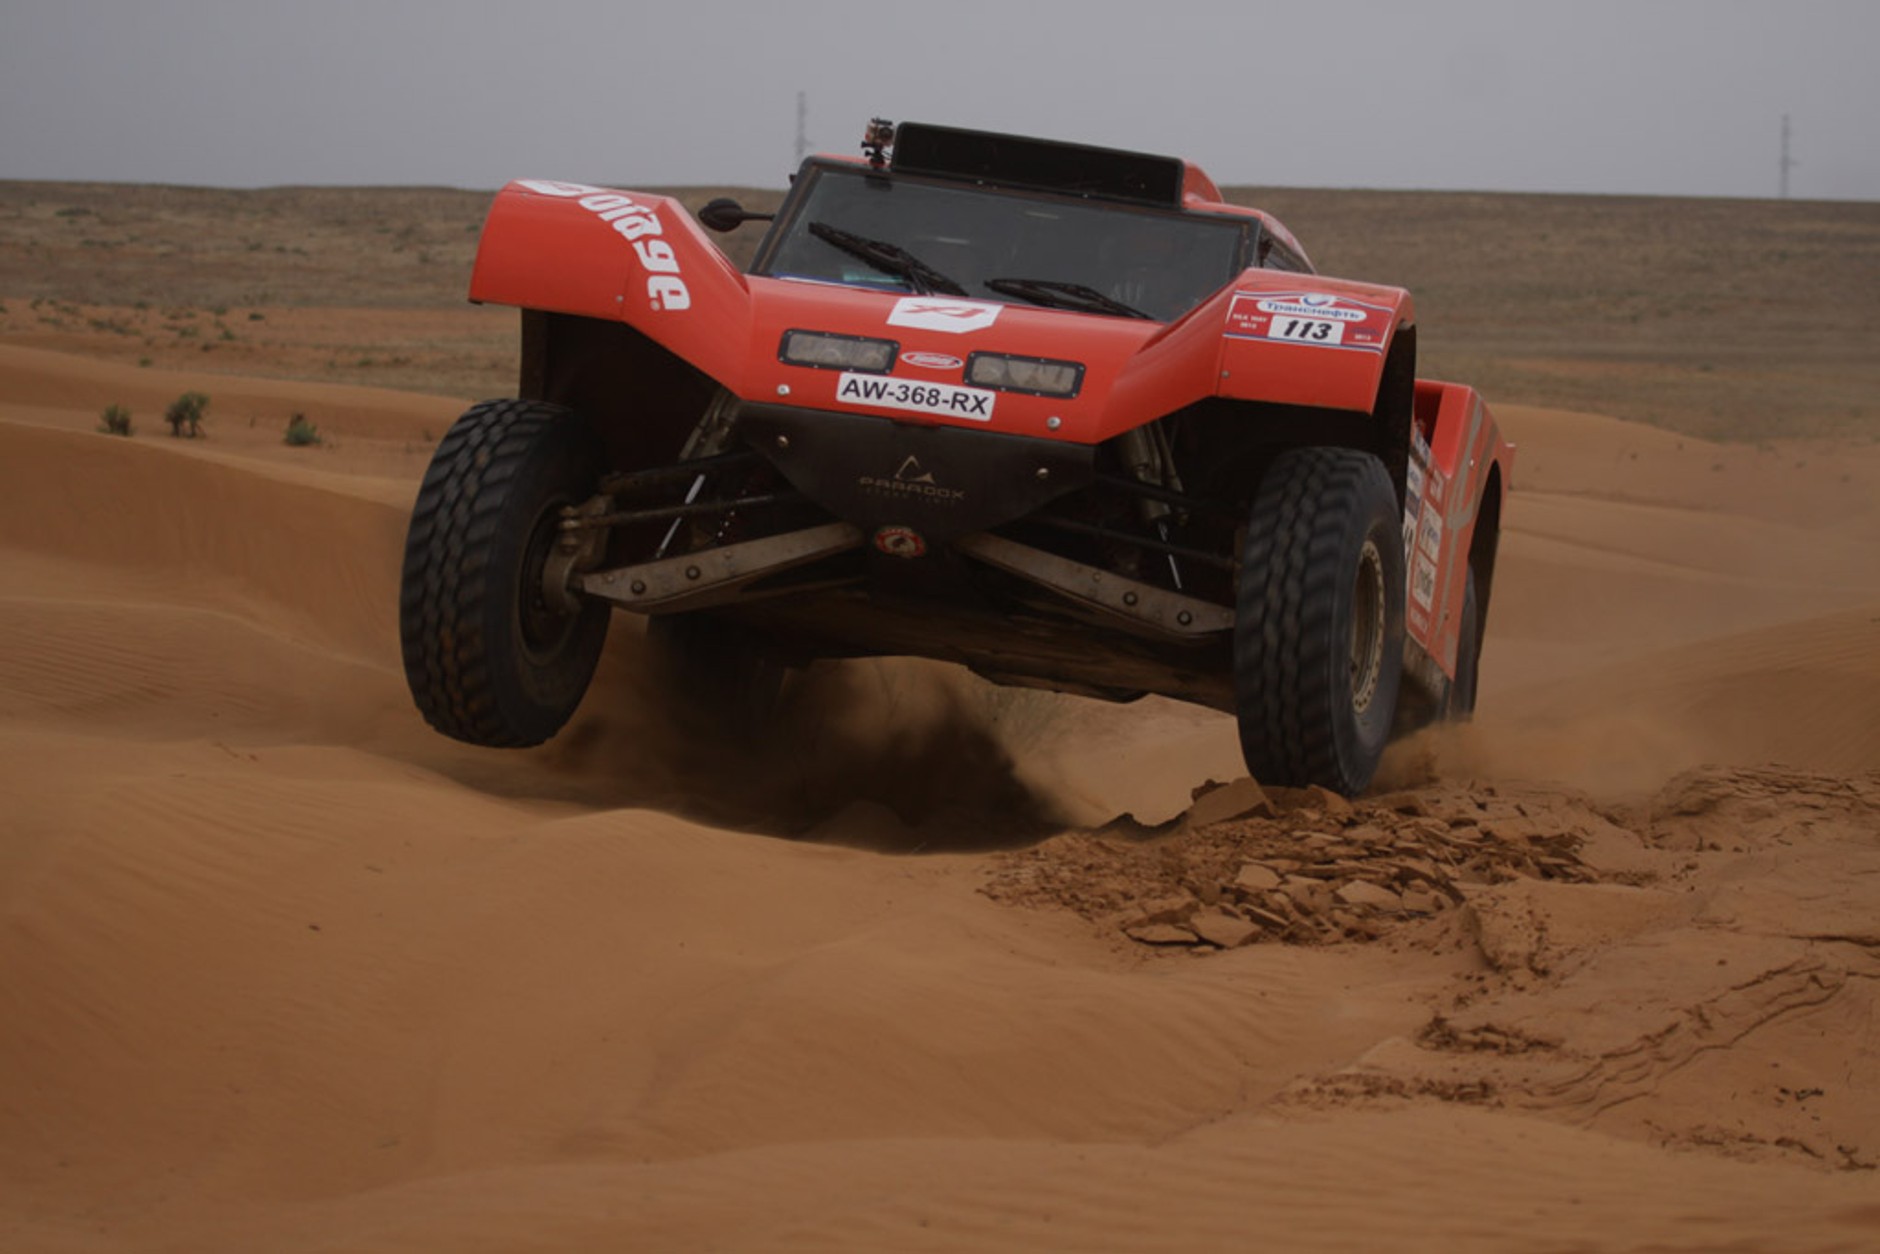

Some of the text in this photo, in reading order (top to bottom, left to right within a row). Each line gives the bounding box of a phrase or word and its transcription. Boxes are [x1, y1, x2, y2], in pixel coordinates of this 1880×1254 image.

[1282, 319, 1334, 341] 113
[840, 377, 991, 417] AW-368-RX
[858, 476, 966, 500] PARADOX
